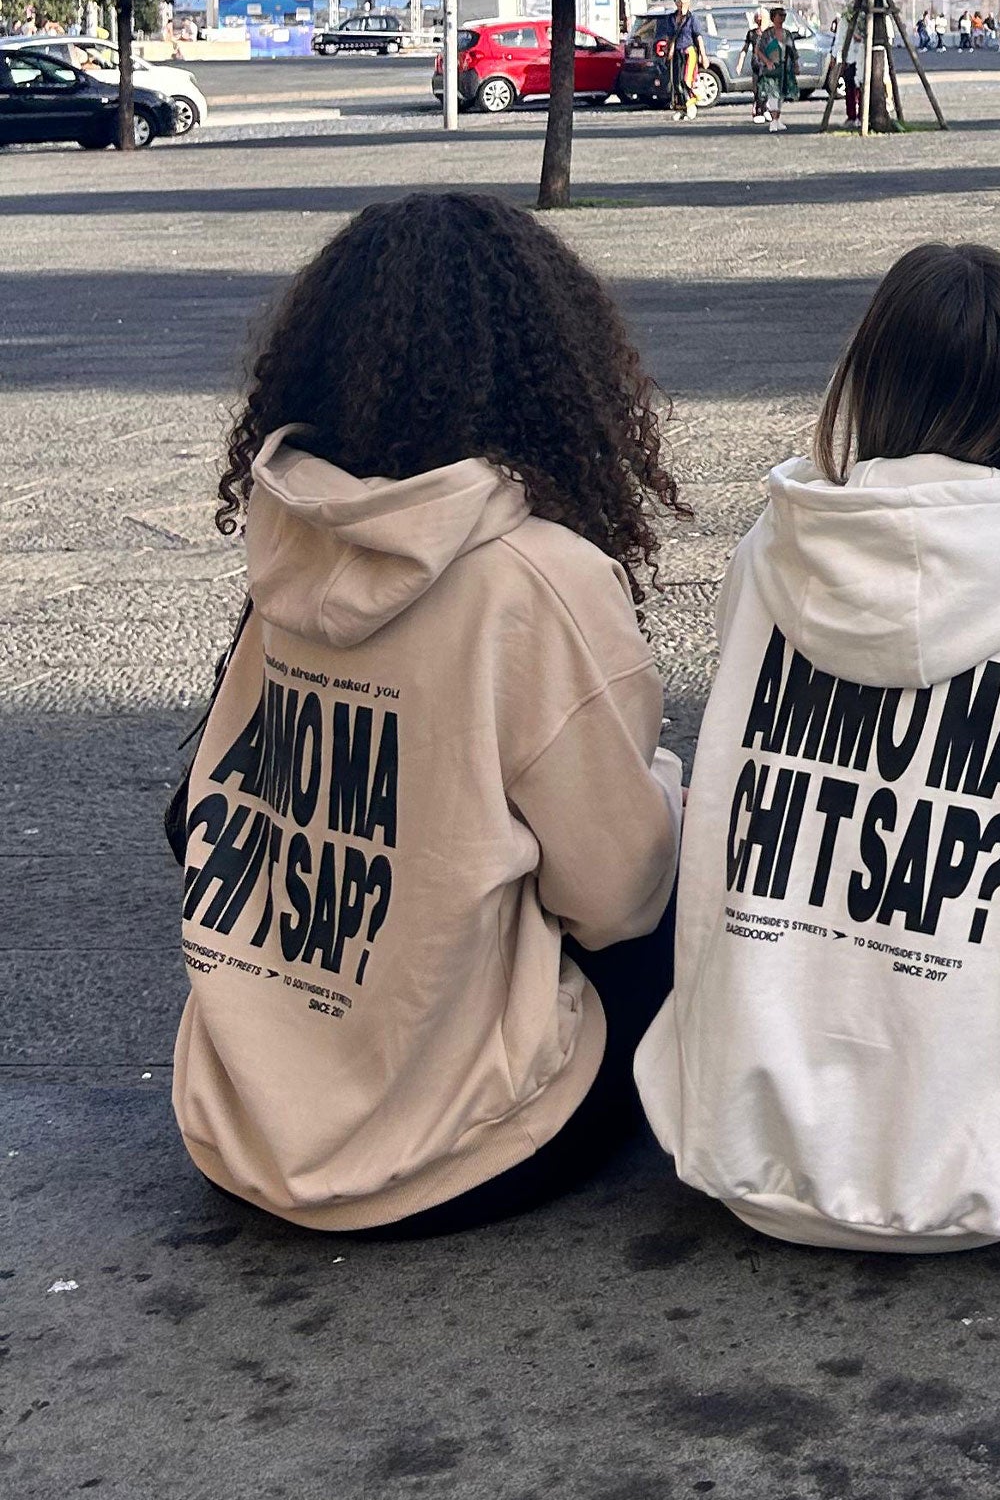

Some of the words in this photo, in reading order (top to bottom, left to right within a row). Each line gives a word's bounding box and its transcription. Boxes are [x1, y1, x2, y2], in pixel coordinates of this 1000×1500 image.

[290, 666, 330, 687] already
[332, 678, 371, 694] asked
[373, 685, 401, 699] you
[741, 623, 933, 782] AMMO
[328, 701, 398, 848] MA
[182, 938, 227, 962] OUTHSIDE'S
[226, 957, 262, 976] STREETS
[283, 975, 292, 986] TO
[791, 921, 828, 937] STREETS
[854, 937, 865, 947] TO
[866, 940, 922, 961] SOUTHSIDE'S
[923, 954, 963, 969] STREETS
[892, 962, 923, 977] SINCE
[925, 969, 948, 982] 2017
[308, 998, 331, 1015] SINCE
